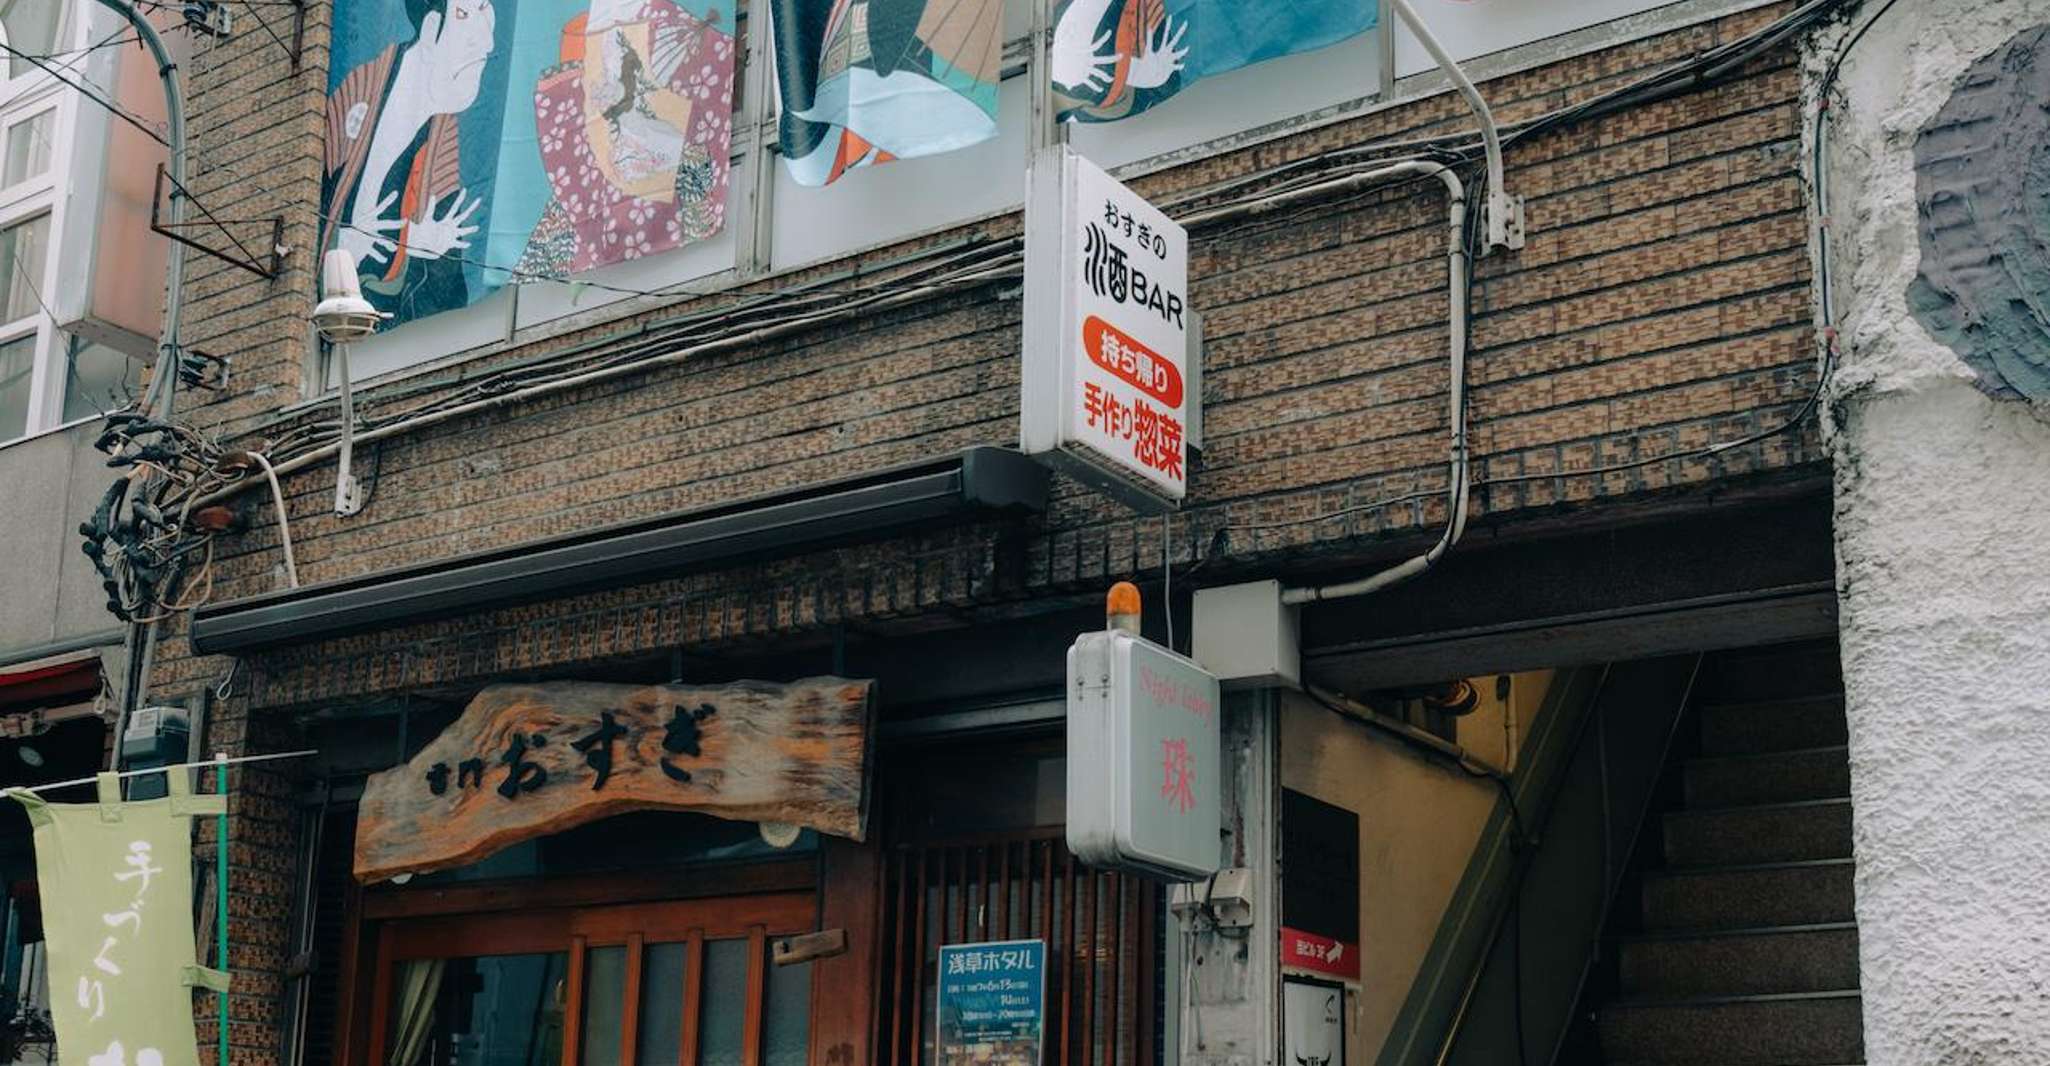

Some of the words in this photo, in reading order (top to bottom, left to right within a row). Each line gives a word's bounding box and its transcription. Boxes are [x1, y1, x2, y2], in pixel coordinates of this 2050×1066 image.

[1104, 199, 1167, 261] おすぎの
[1100, 329, 1169, 393] 持ち帰り
[1084, 381, 1183, 482] 手作り惣菜
[76, 840, 163, 1023] 手づくり
[948, 949, 1035, 974] 浅草ホタル
